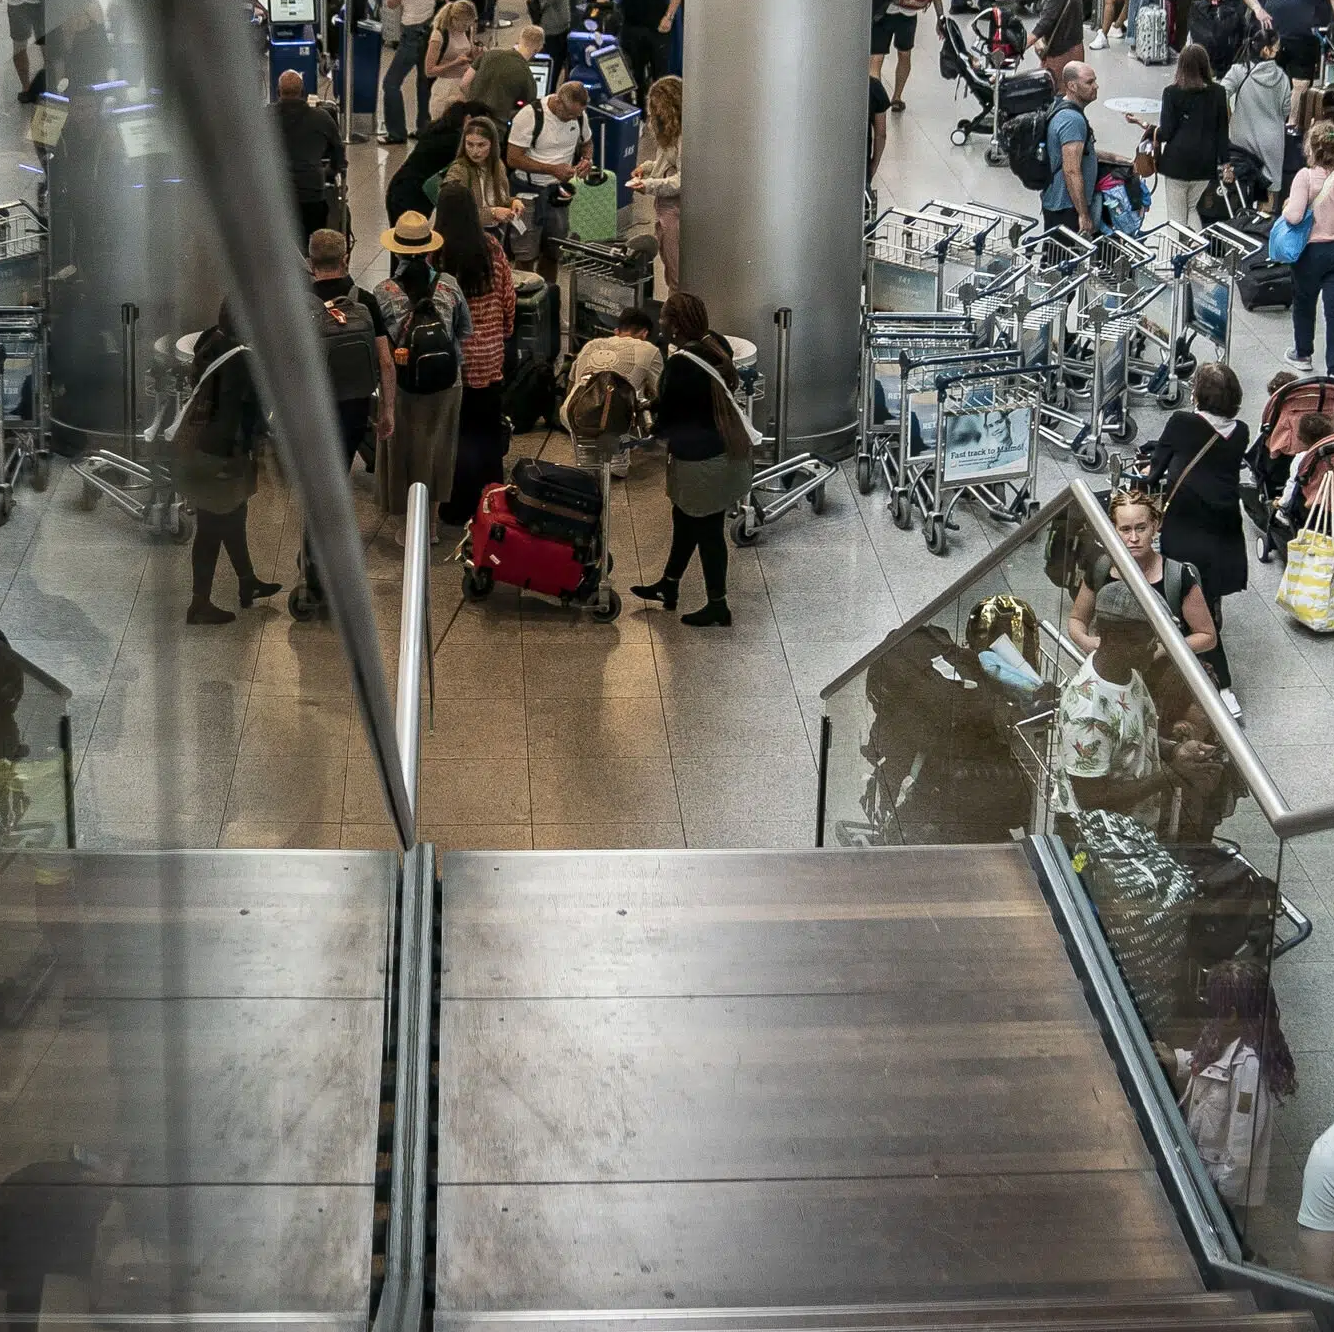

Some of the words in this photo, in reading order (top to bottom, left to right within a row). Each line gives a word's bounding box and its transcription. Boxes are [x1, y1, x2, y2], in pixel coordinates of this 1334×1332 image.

[950, 451, 966, 459] Fast
[968, 448, 986, 458] track
[987, 447, 997, 455] to
